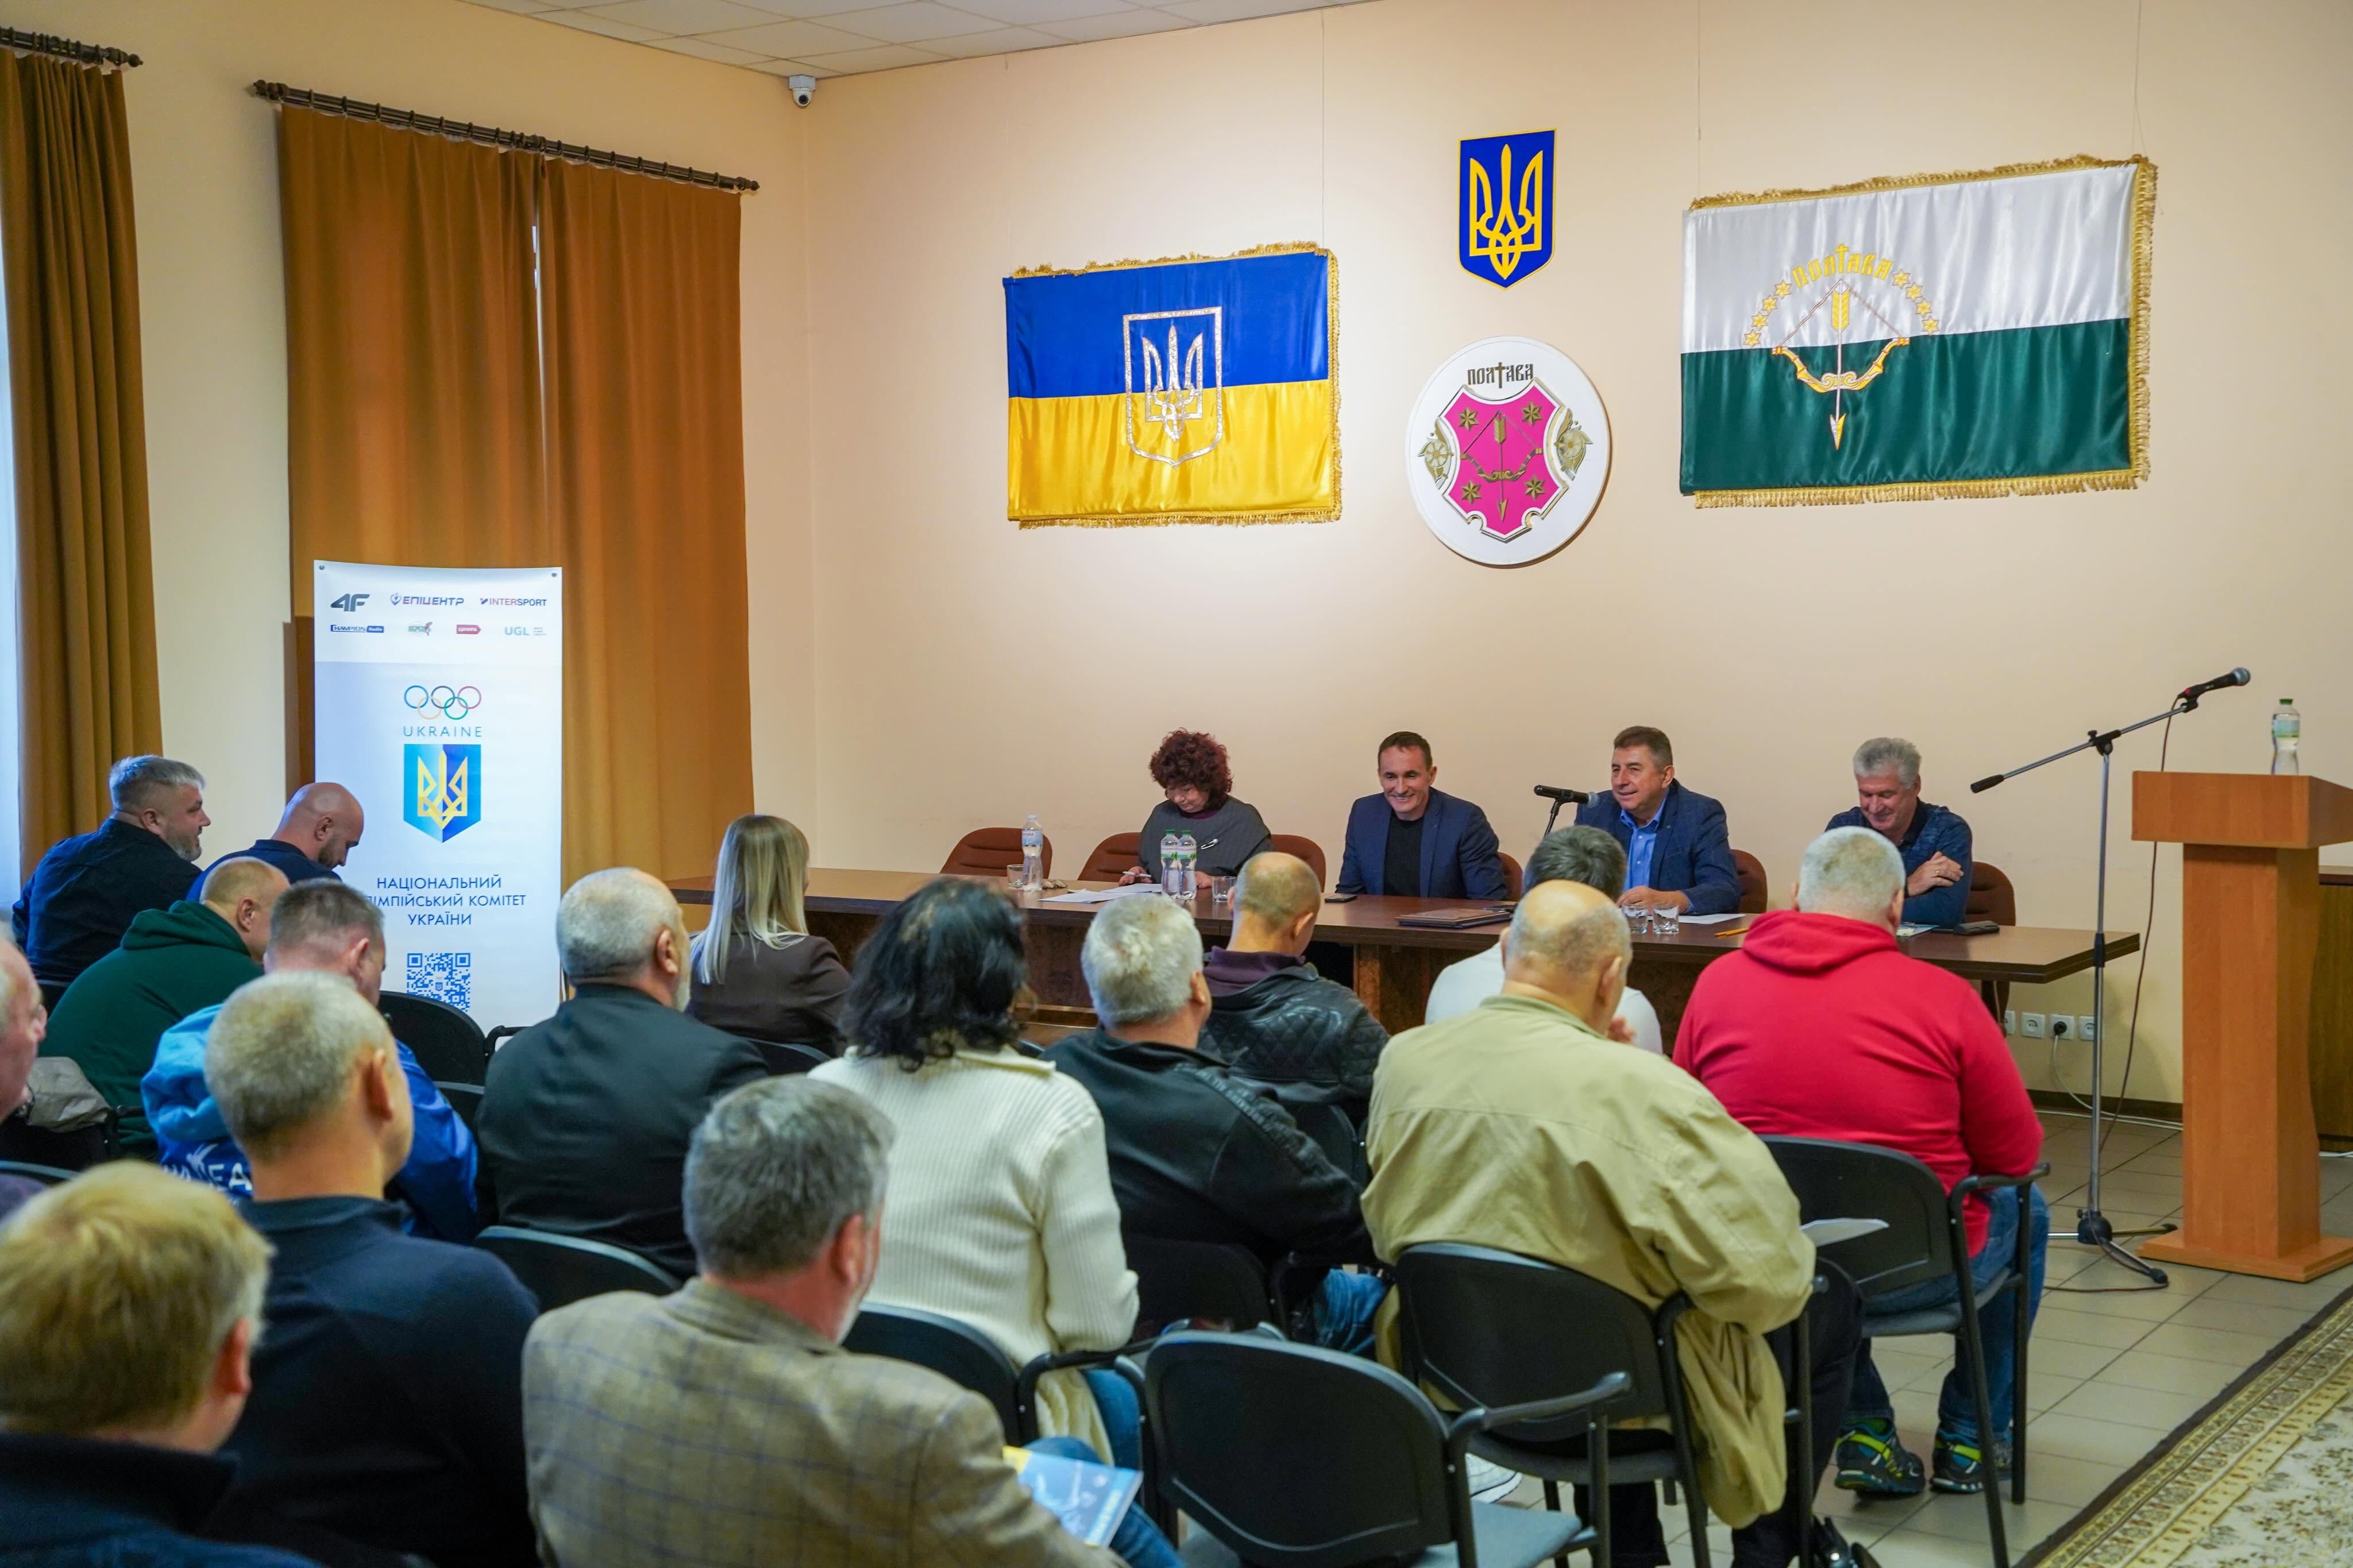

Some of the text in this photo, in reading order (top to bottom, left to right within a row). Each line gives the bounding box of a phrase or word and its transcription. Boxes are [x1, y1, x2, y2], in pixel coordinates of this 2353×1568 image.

[1468, 362, 1533, 388] ПОЛТАВА
[330, 593, 370, 612] 4F
[403, 596, 464, 605] ЕПІЦЕНТР
[489, 598, 547, 606] INTERSPORT
[504, 626, 529, 636] UGL
[403, 726, 482, 737] UKRAINE
[377, 874, 502, 891] НАЦІОНАЛЬНИЙ
[469, 895, 526, 906] КОМІТЕТ
[408, 911, 472, 925] УКРАЇНИ
